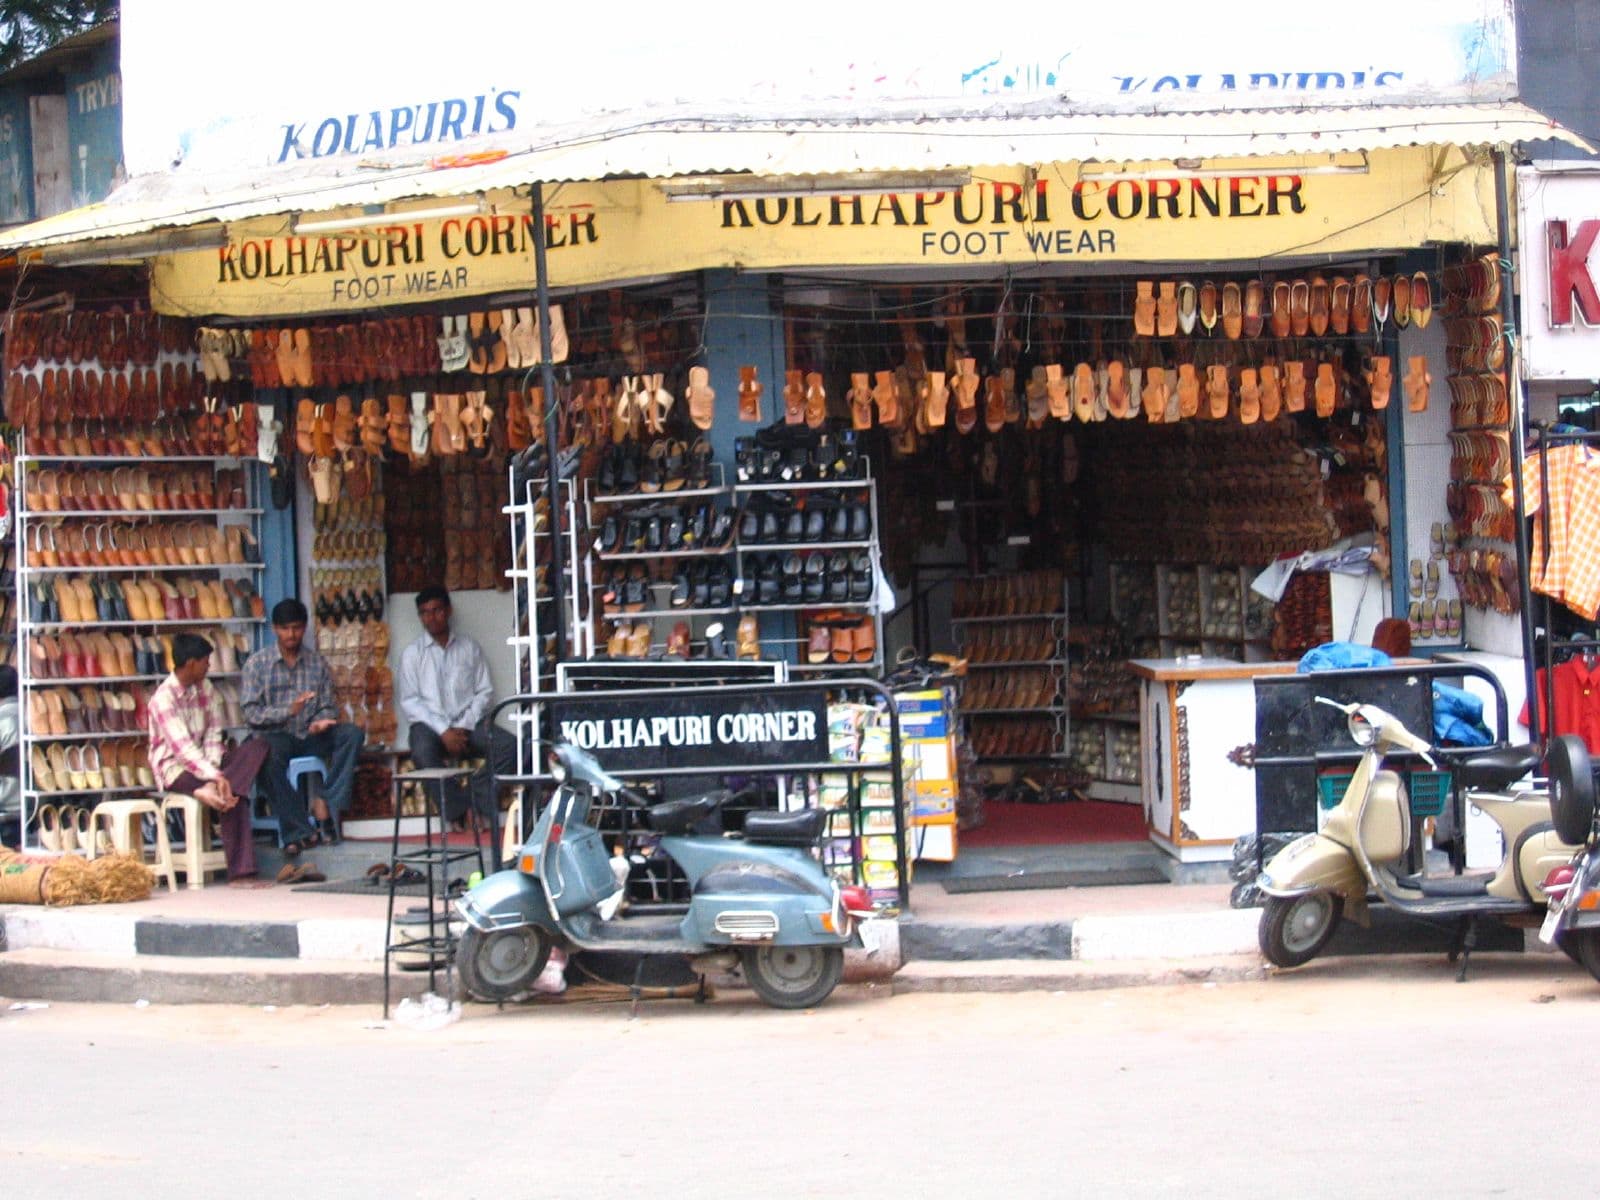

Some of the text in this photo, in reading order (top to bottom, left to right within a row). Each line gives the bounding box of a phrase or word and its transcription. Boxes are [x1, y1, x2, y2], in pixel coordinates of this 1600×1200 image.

[276, 86, 521, 164] KOLAPURI'S
[720, 174, 1306, 228] KOLHAPURI CORNER
[217, 223, 425, 283] KOLHAPURI
[922, 229, 1116, 256] FOOT WEAR
[333, 266, 468, 302] FOOT WEAR
[560, 710, 817, 750] KOLHAPURI CORNER
